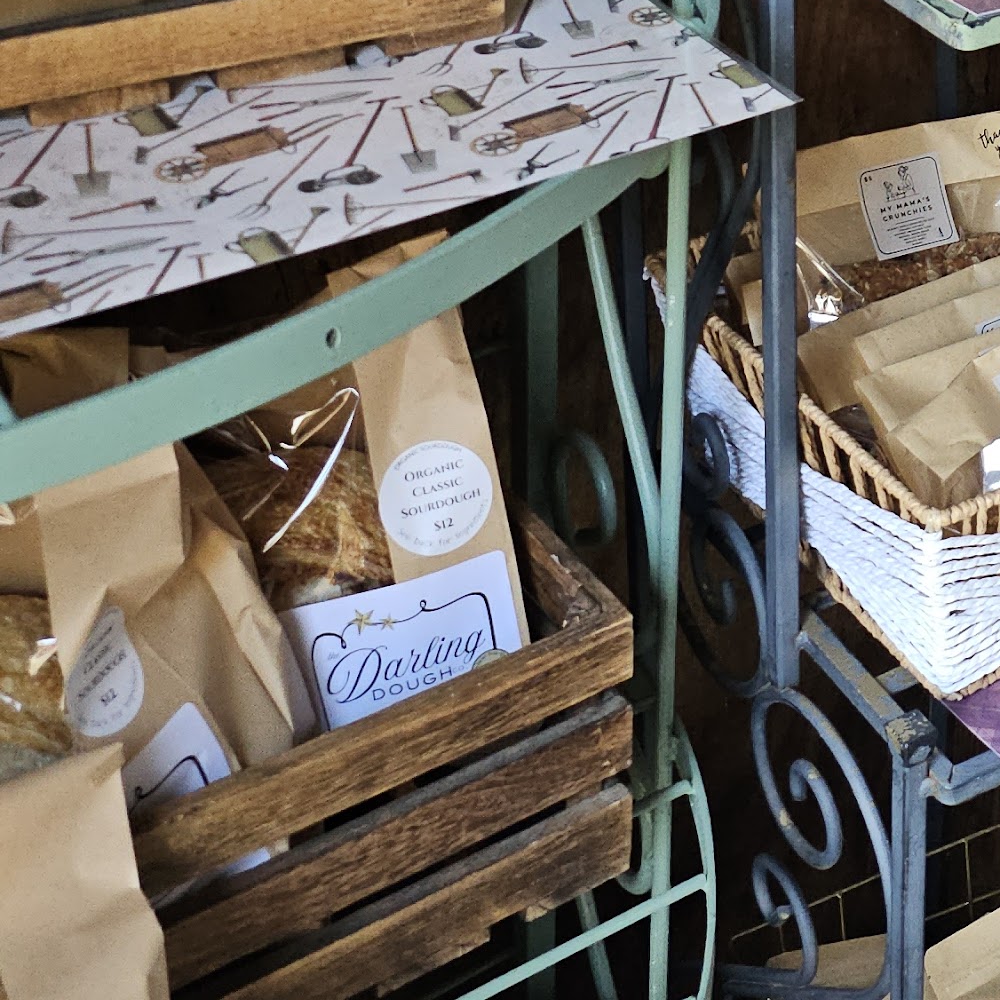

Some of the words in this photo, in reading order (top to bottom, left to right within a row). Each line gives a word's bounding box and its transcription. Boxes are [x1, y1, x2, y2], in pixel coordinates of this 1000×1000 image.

[880, 205, 892, 213] MY
[896, 196, 930, 208] MAMA'S
[882, 205, 933, 222] CRUNCHIES
[404, 459, 465, 482] ORGANIC
[412, 477, 464, 497] CLASSIC
[400, 488, 481, 519] SOURDOUGH
[433, 517, 454, 531] $12
[327, 629, 486, 704] Darling
[373, 666, 453, 701] DOUGH
